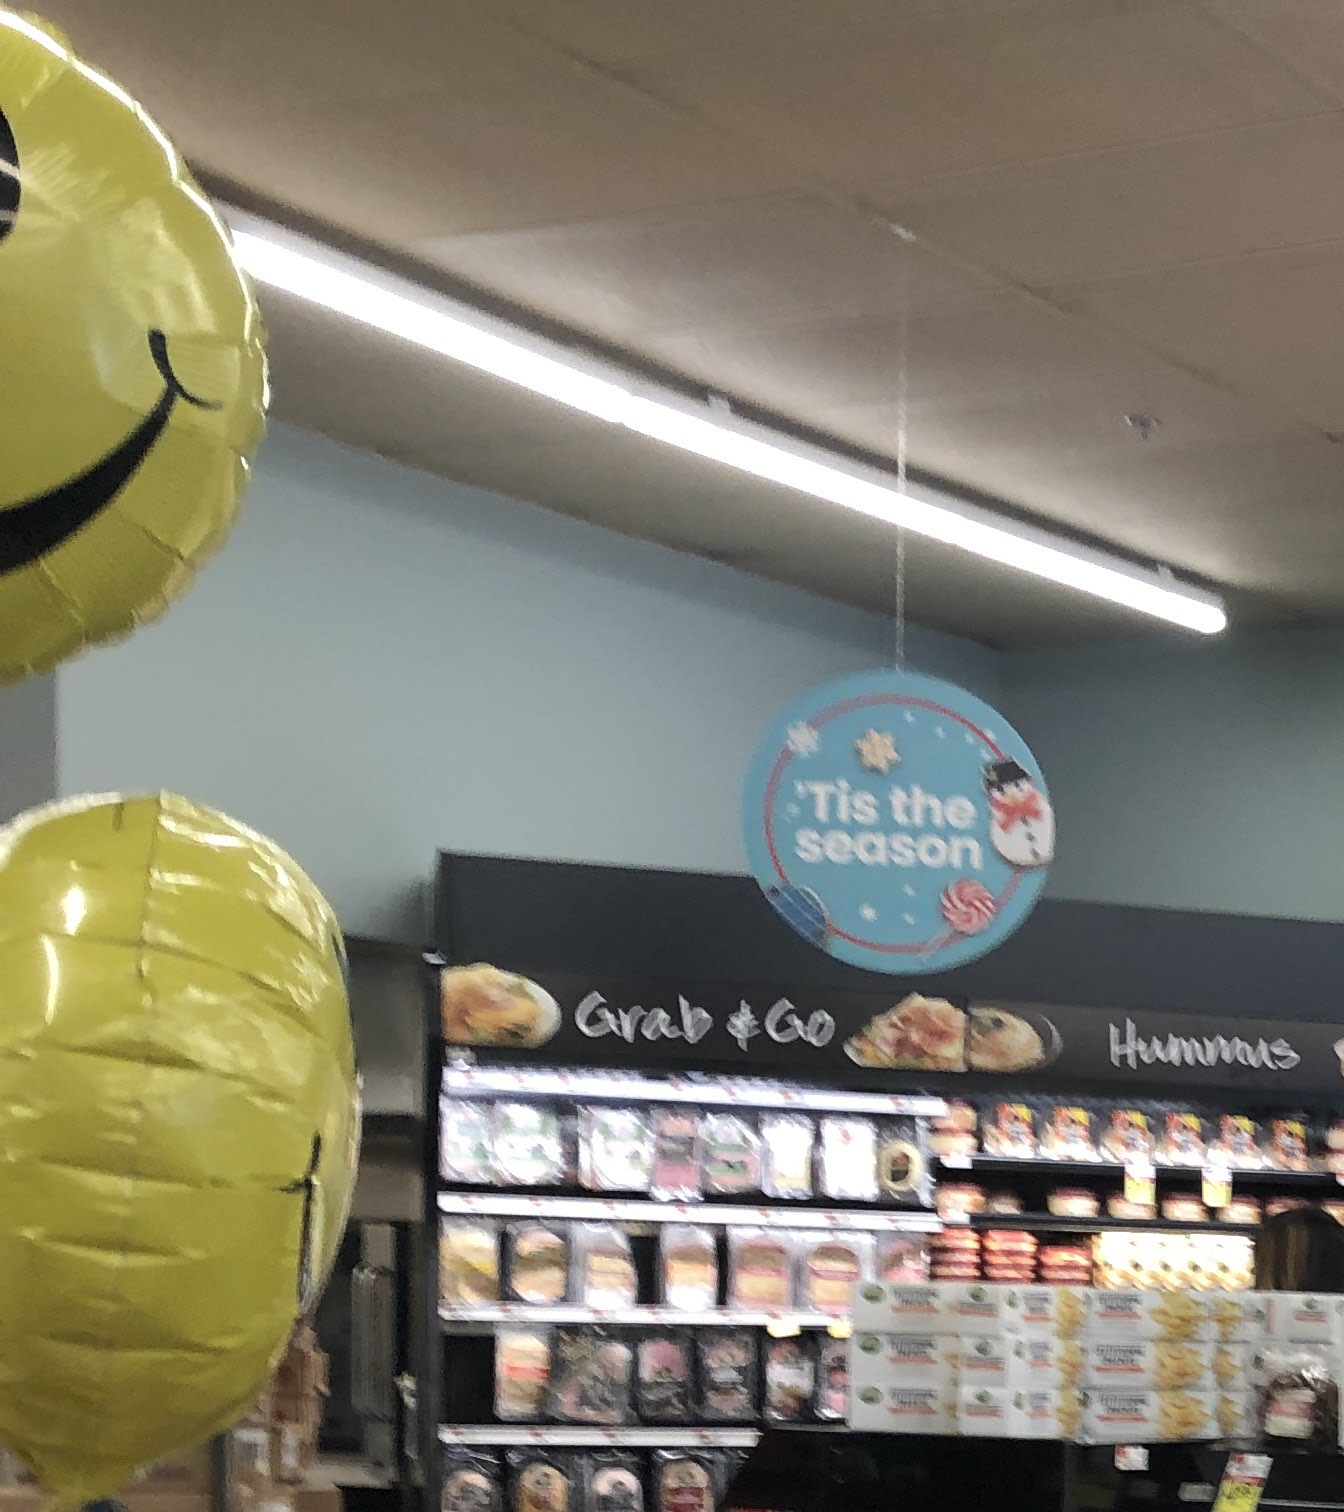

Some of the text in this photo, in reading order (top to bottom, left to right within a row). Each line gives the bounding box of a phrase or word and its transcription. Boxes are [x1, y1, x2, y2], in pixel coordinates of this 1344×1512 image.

[794, 778, 979, 830] 'Tis the
[795, 828, 985, 870] season
[574, 990, 713, 1044] Grab
[764, 997, 836, 1047] Go
[1109, 1017, 1301, 1070] Hummus
